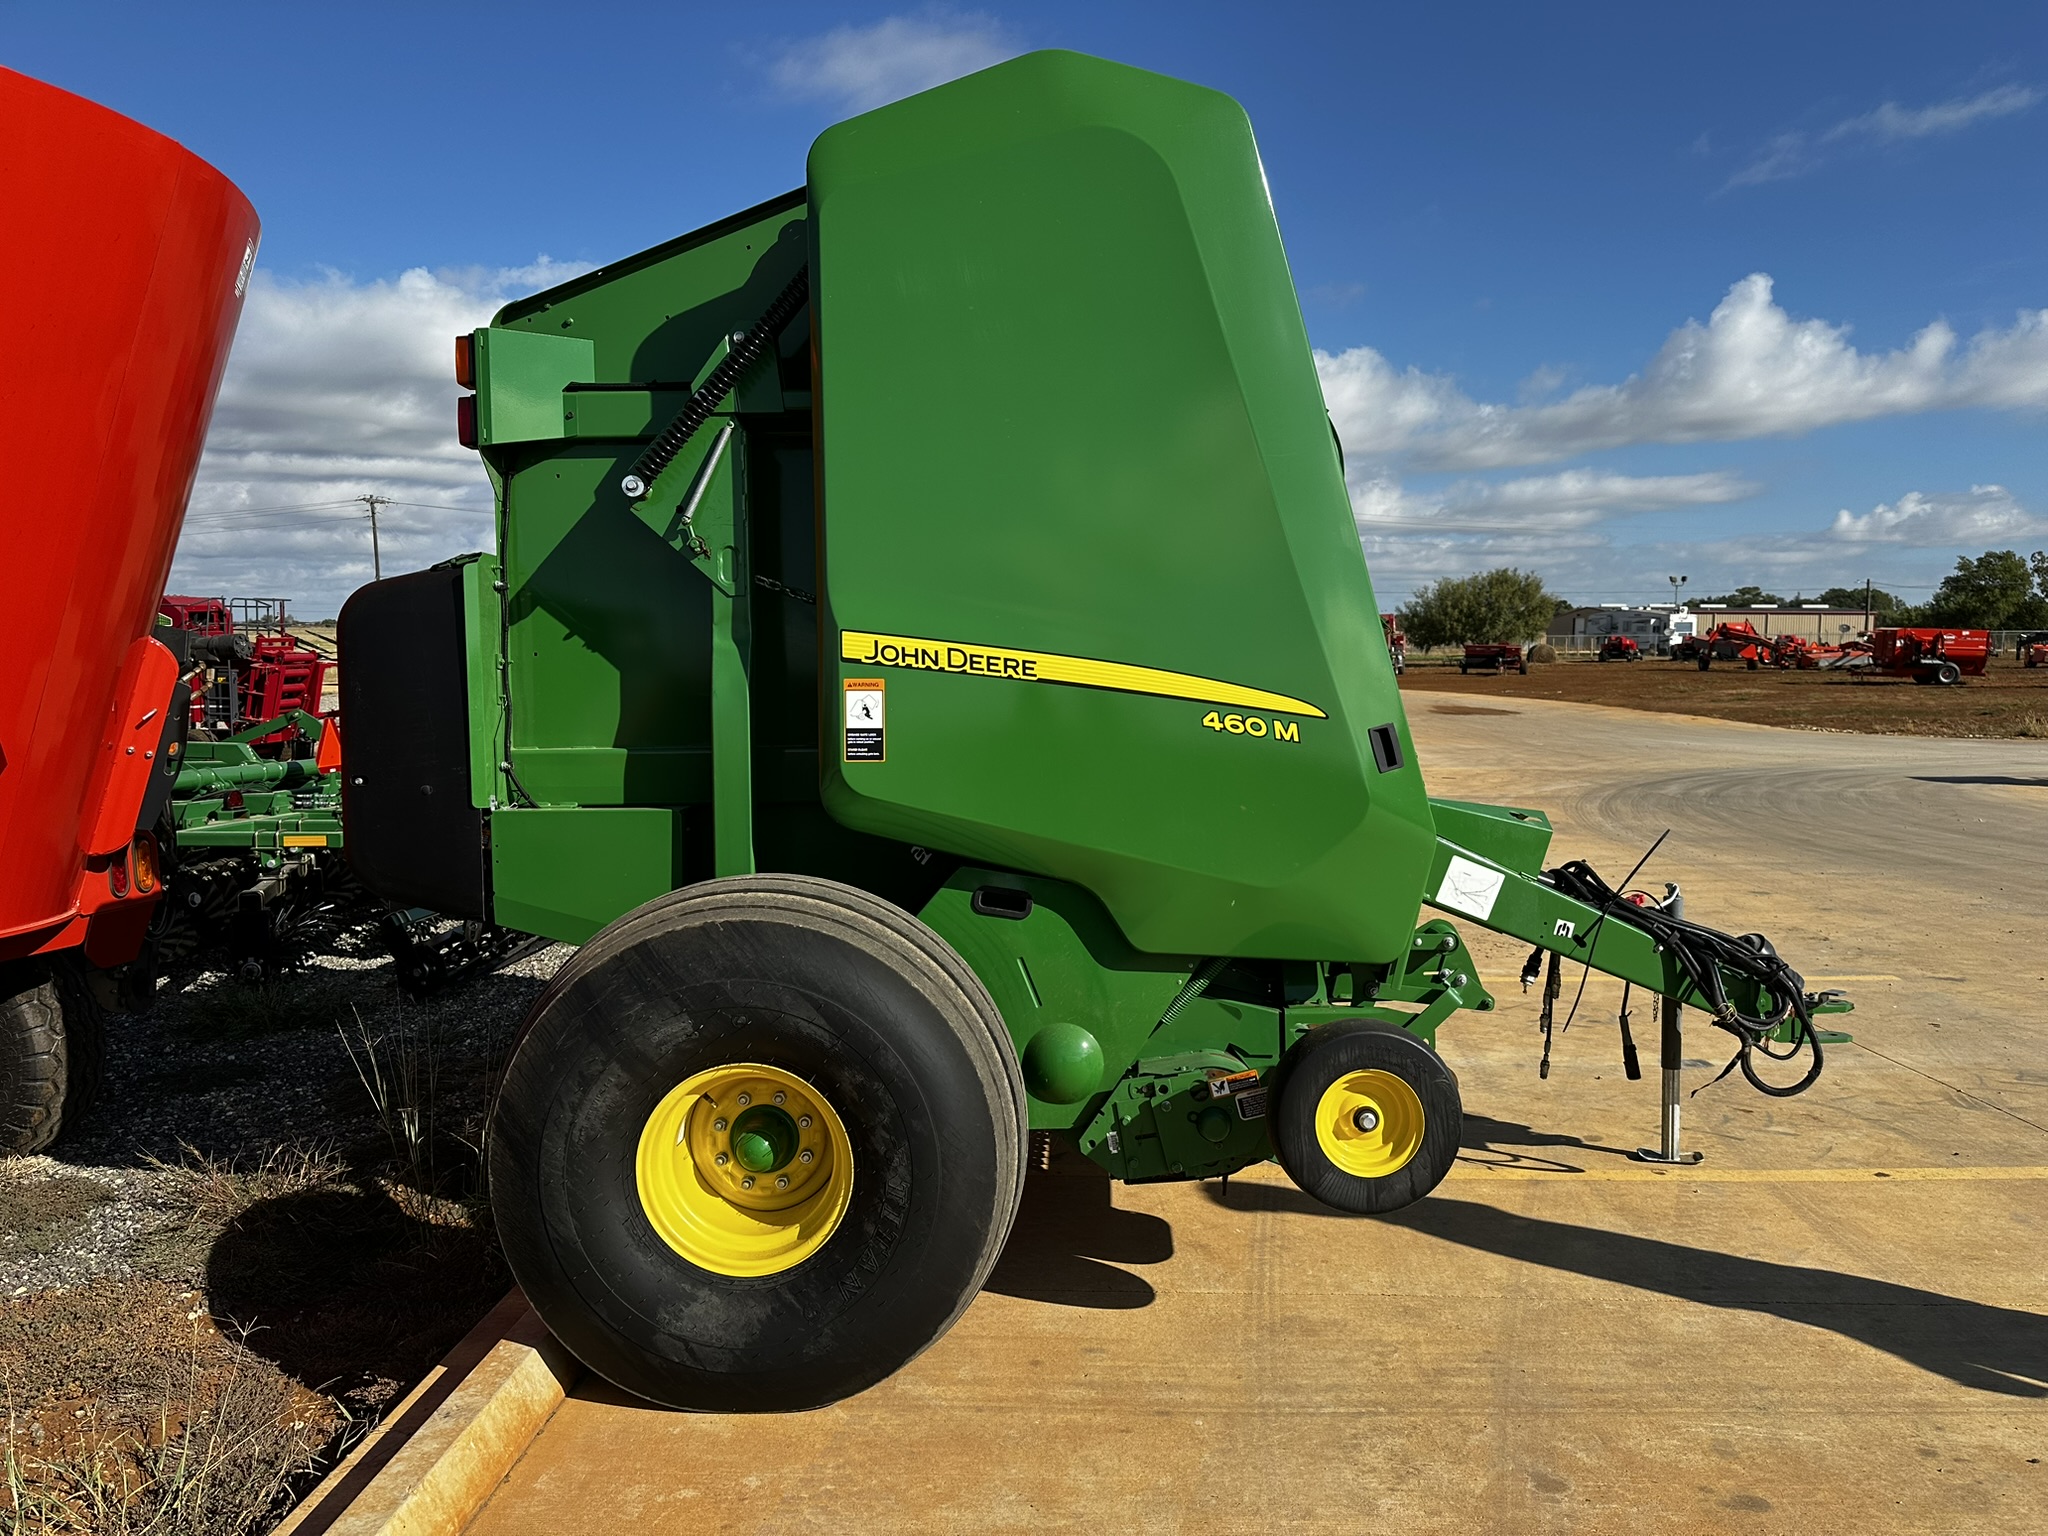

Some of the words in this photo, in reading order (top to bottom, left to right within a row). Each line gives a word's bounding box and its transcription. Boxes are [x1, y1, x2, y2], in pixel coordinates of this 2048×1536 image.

[864, 640, 939, 667] JOHN
[947, 647, 1037, 677] DEERE
[1202, 710, 1268, 738] 460
[1272, 719, 1301, 743] M
[837, 1179, 910, 1301] TITAN
